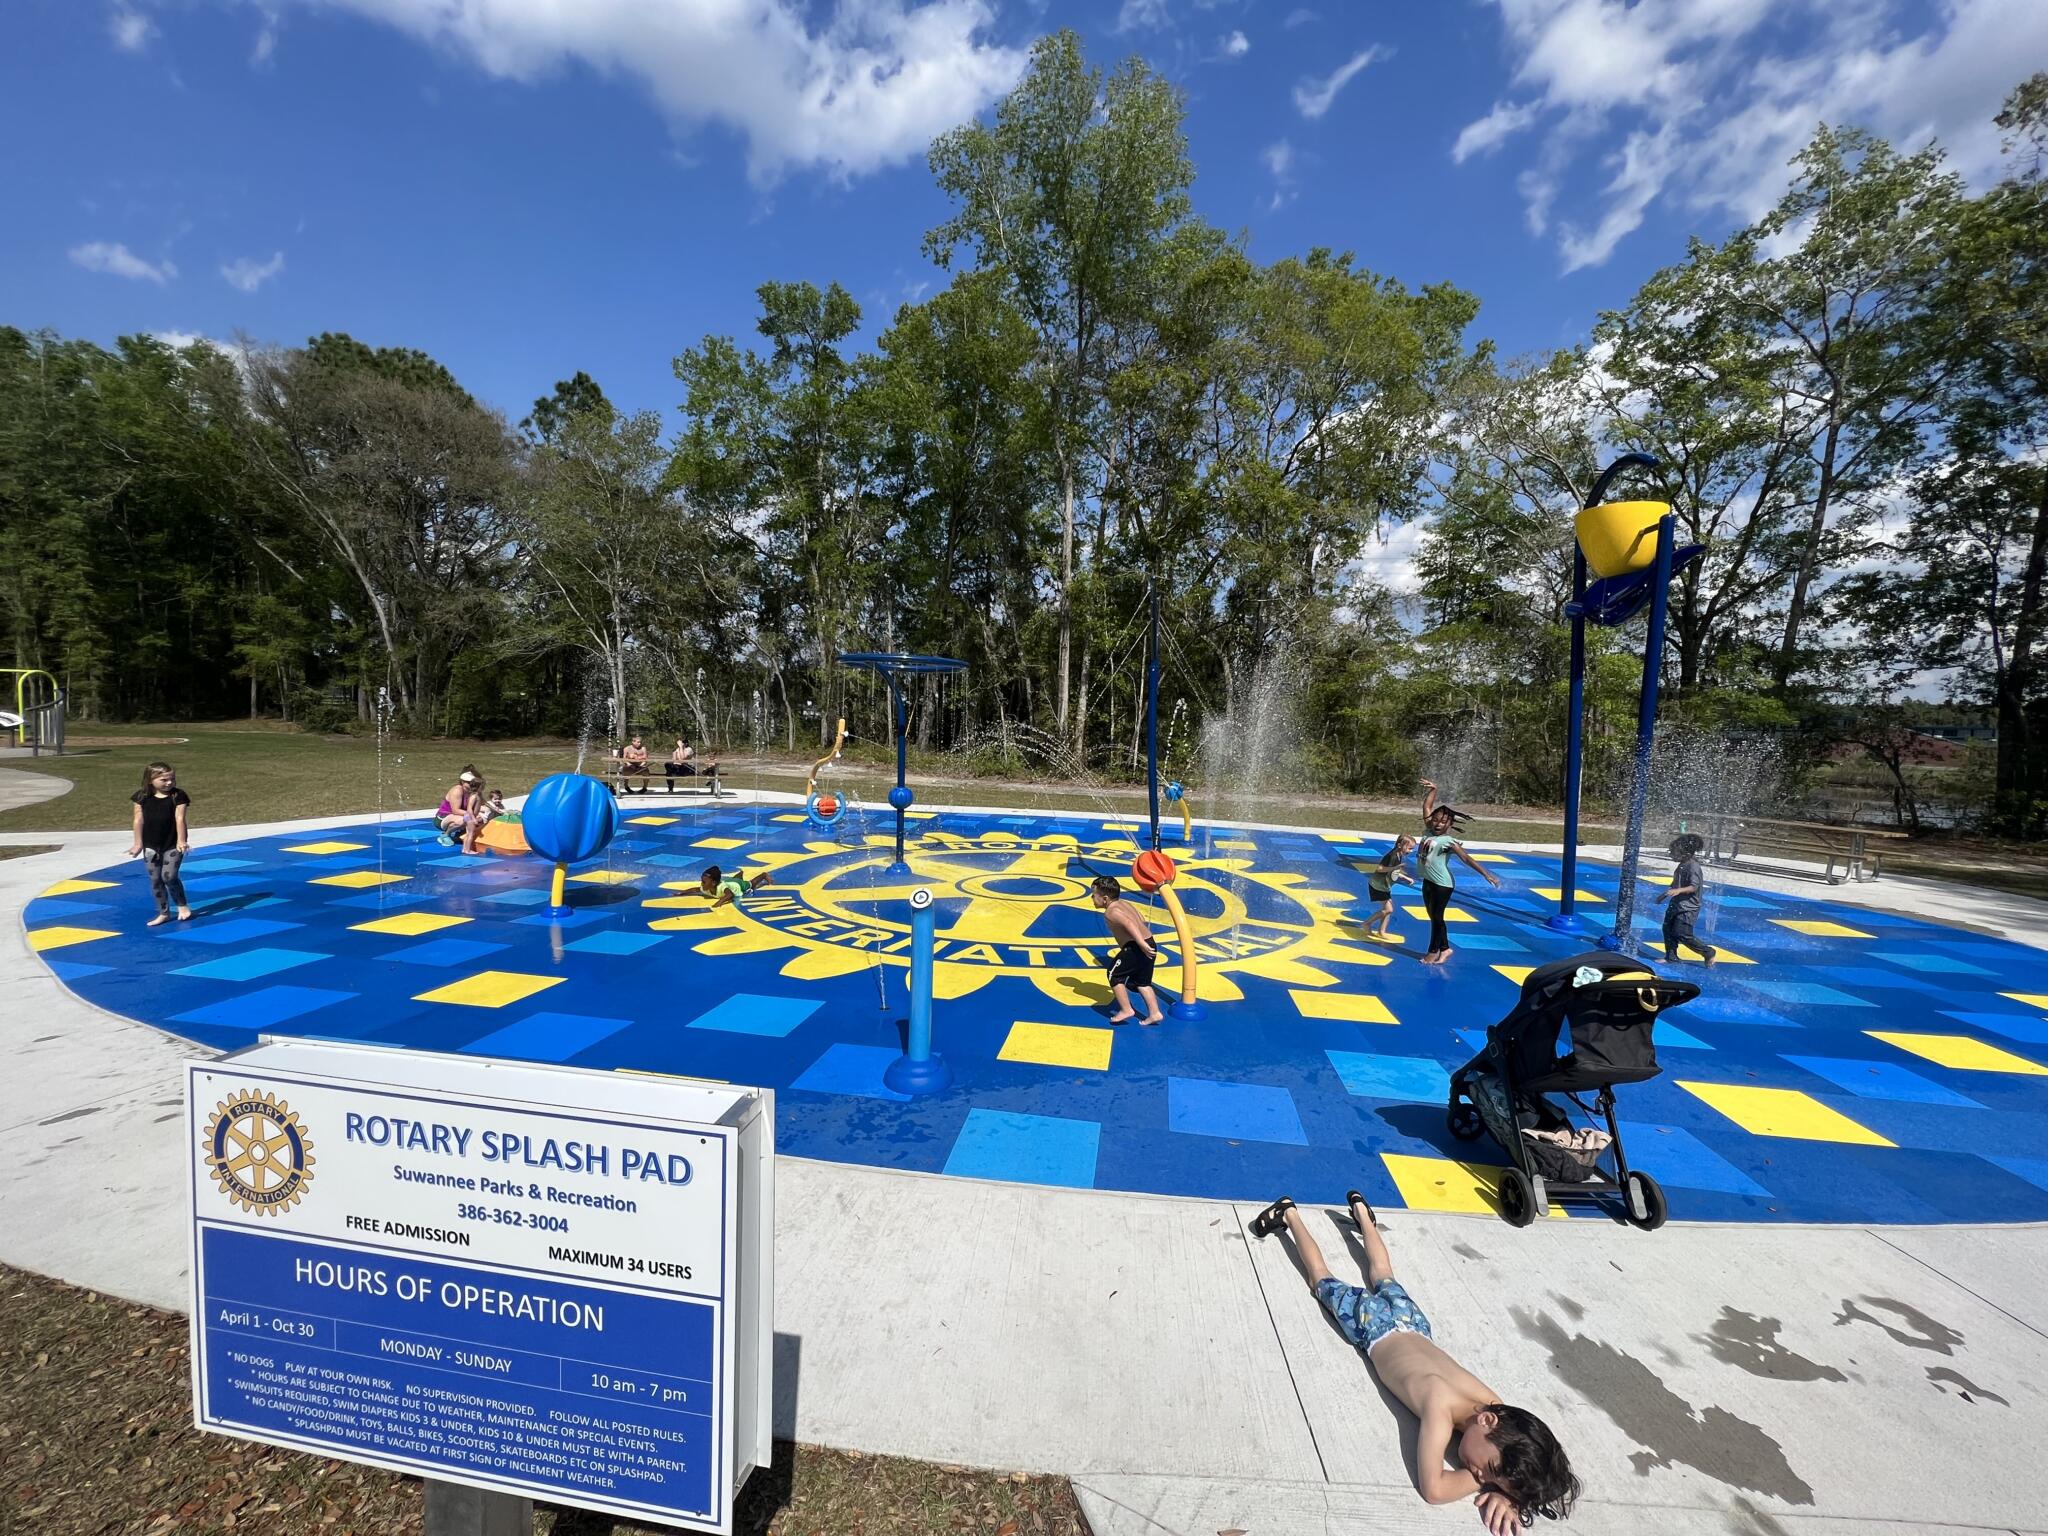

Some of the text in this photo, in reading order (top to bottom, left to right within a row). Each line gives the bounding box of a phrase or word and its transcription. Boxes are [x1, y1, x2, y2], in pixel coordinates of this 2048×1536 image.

[942, 841, 1138, 861] ROTAR
[234, 1102, 281, 1120] ROTARY
[346, 1112, 693, 1186] ROTARY SPLASH PAD
[221, 1168, 300, 1203] INTERNATIONAL
[393, 1164, 637, 1213] Suwannee Parks & Recreation
[346, 1215, 469, 1246] FREE ADMISSION
[457, 1203, 569, 1233] 386-362-3004
[548, 1246, 692, 1280] MAXIMUM 34 USERS
[296, 1258, 603, 1331] HOURS OF OPERATION
[219, 1309, 249, 1326] April
[253, 1315, 260, 1328] 1
[272, 1318, 295, 1334] Oct
[298, 1322, 314, 1337] 30
[381, 1338, 442, 1360] MONDAY
[455, 1351, 512, 1373] SUNDAY
[234, 1352, 686, 1443] NO DOGS PLAY AT YOUR OWN RISK. NO SUPERVISION PROVIDED. FOLLOW ALL POSTED RULES.
[591, 1373, 609, 1388] 10
[612, 1380, 635, 1393] am
[649, 1383, 658, 1396] 7
[663, 1388, 686, 1402] pm
[234, 1379, 686, 1473] SWIMSUITS REQUIRED, SWIM DIAPERS KIDS 3 & UNDER, KIDS 10 & UNDER MUST BE WITH A PARENT.
[258, 1370, 658, 1453] HOURS ARE SUBJECT TO CHANGE DUE TO WEATHER, MAINTENANCE OR SPECIAL EVENTS.
[252, 1396, 666, 1483] NO CANDY/FOOD/DRINK, TOYS, BALLS, BIKES, SCOOTERS, SKATEBOARDS ETC ON SPLASHPAD.
[294, 1418, 616, 1488] SPLASHPAD MUST BE VACATED AT FIRST SIGN OF INCLEMENT WEATHER.
